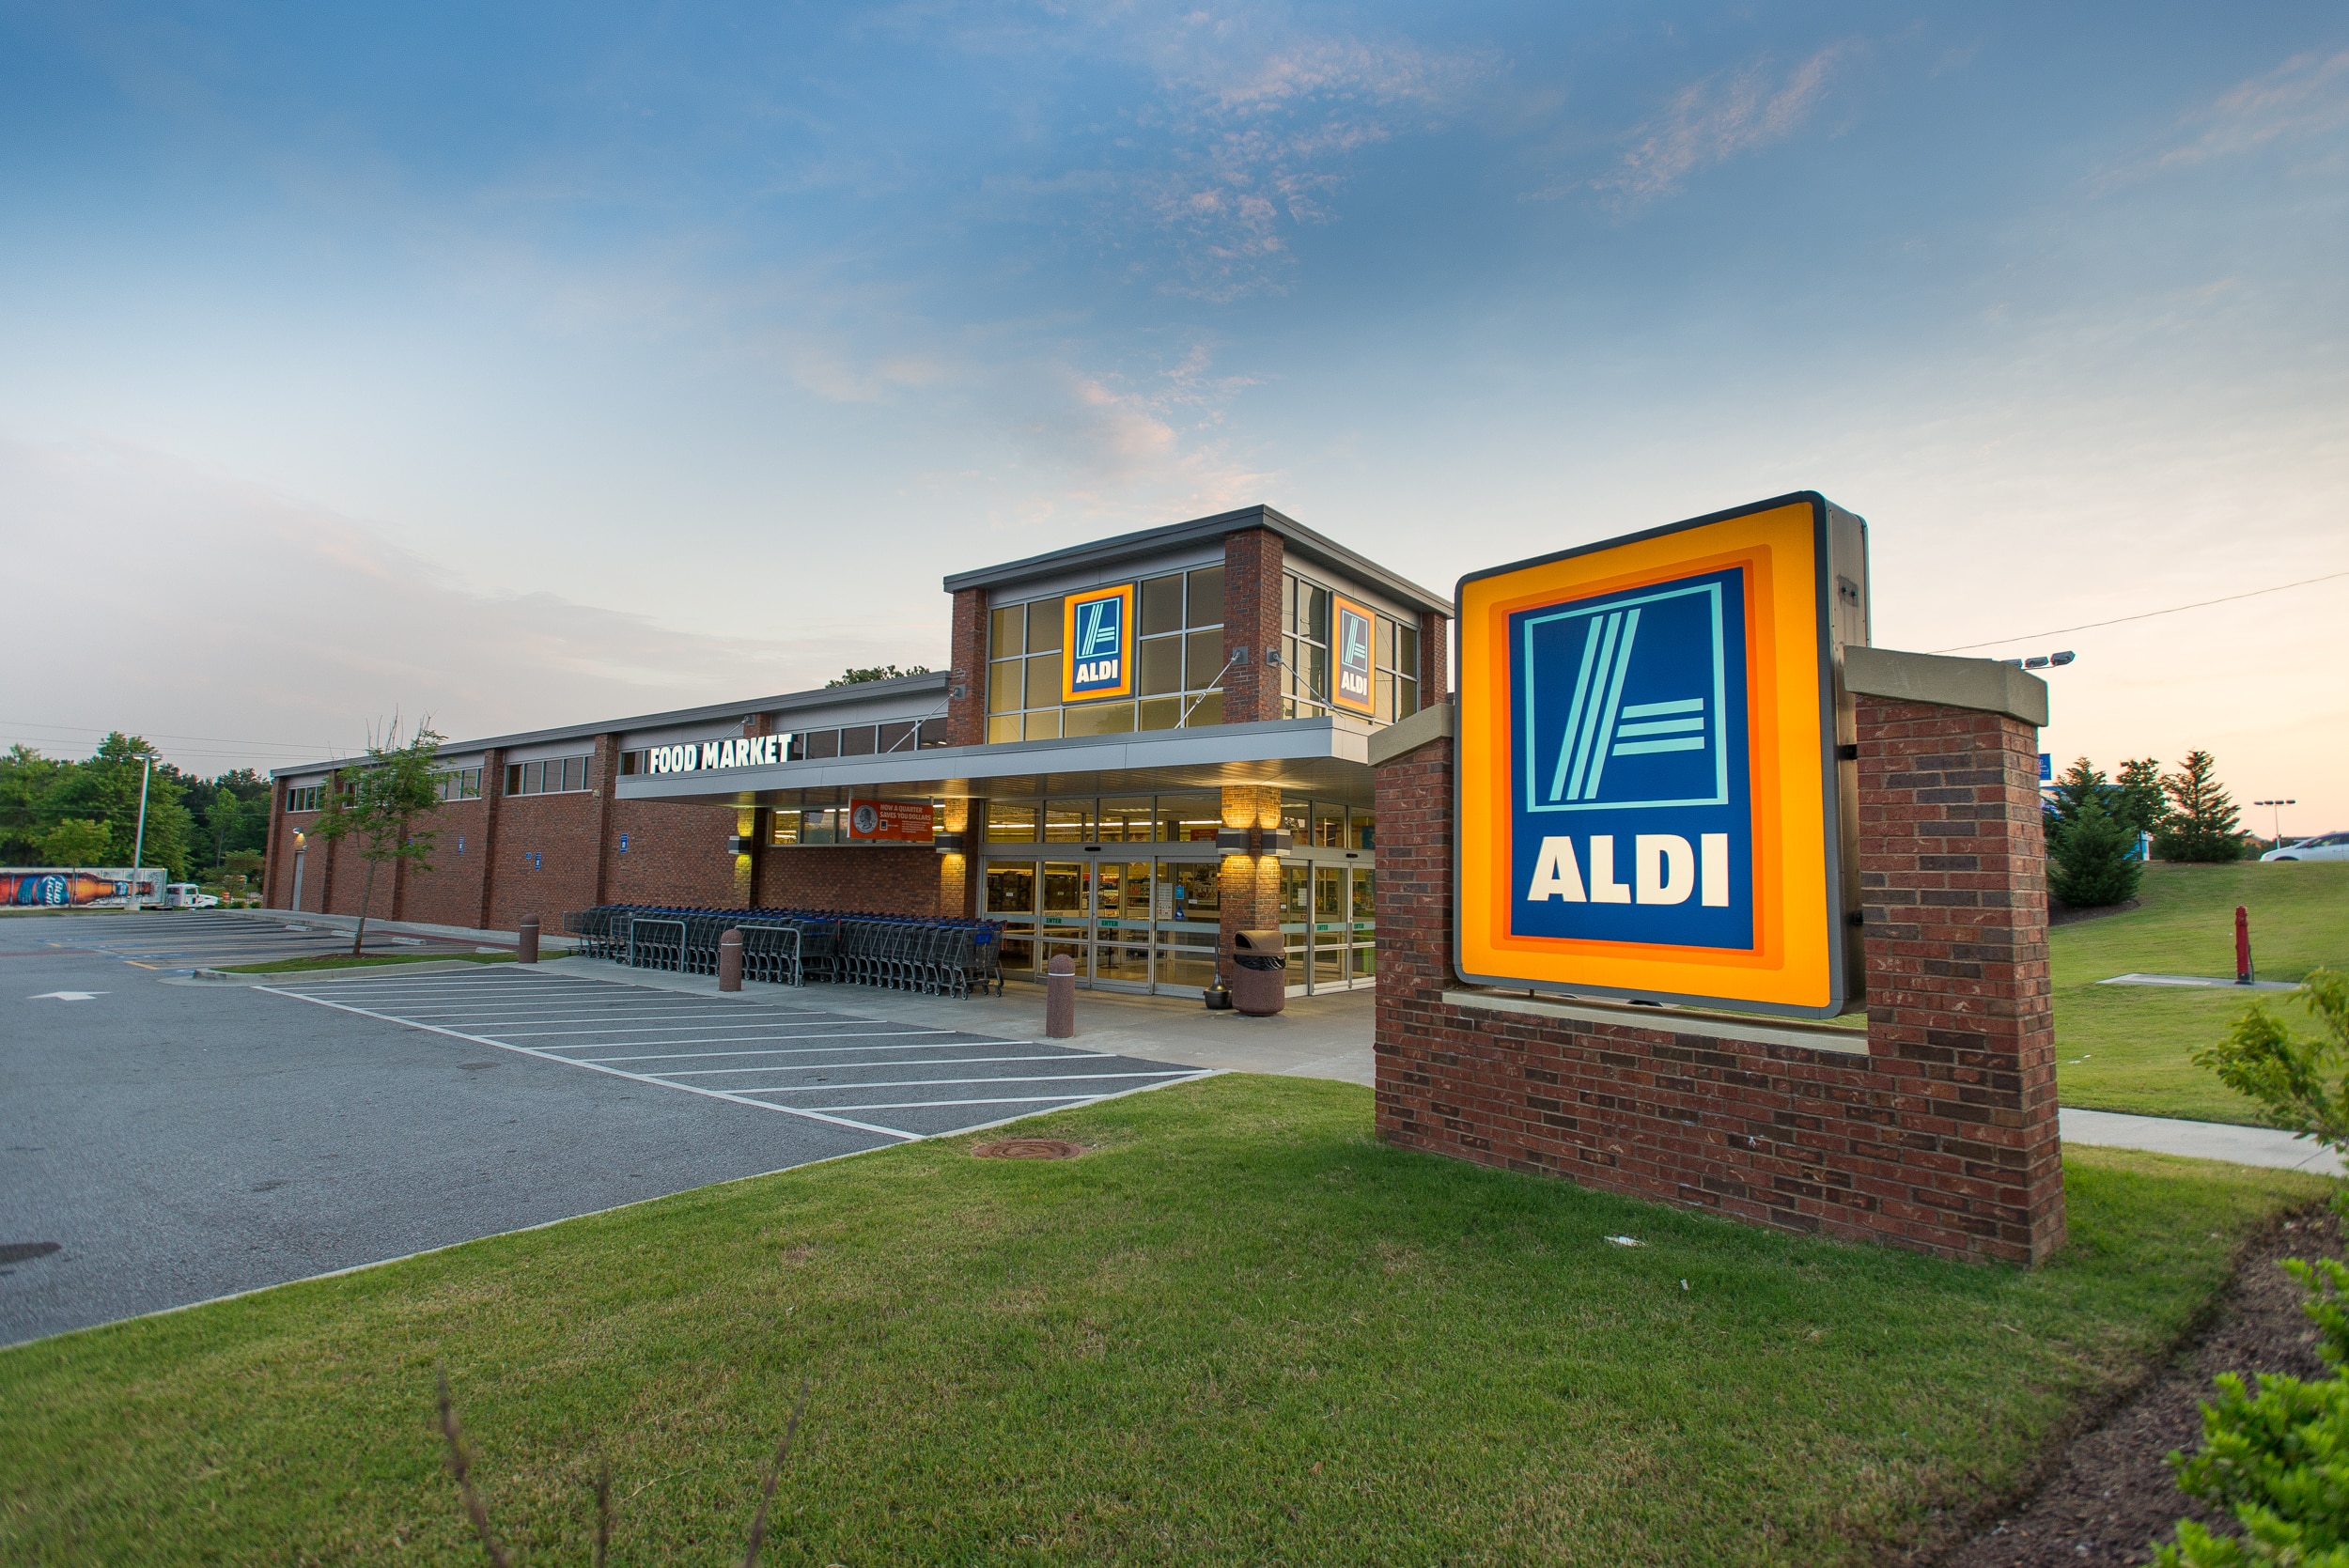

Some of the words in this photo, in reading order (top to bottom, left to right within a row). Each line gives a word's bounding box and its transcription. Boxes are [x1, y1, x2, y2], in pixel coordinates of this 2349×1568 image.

[1076, 659, 1118, 683] ALDI
[1341, 671, 1368, 695] ALDI
[650, 744, 697, 774] FOOD
[701, 733, 793, 770] MARKET
[1527, 832, 1729, 907] ALDI
[54, 880, 64, 904] BUD
